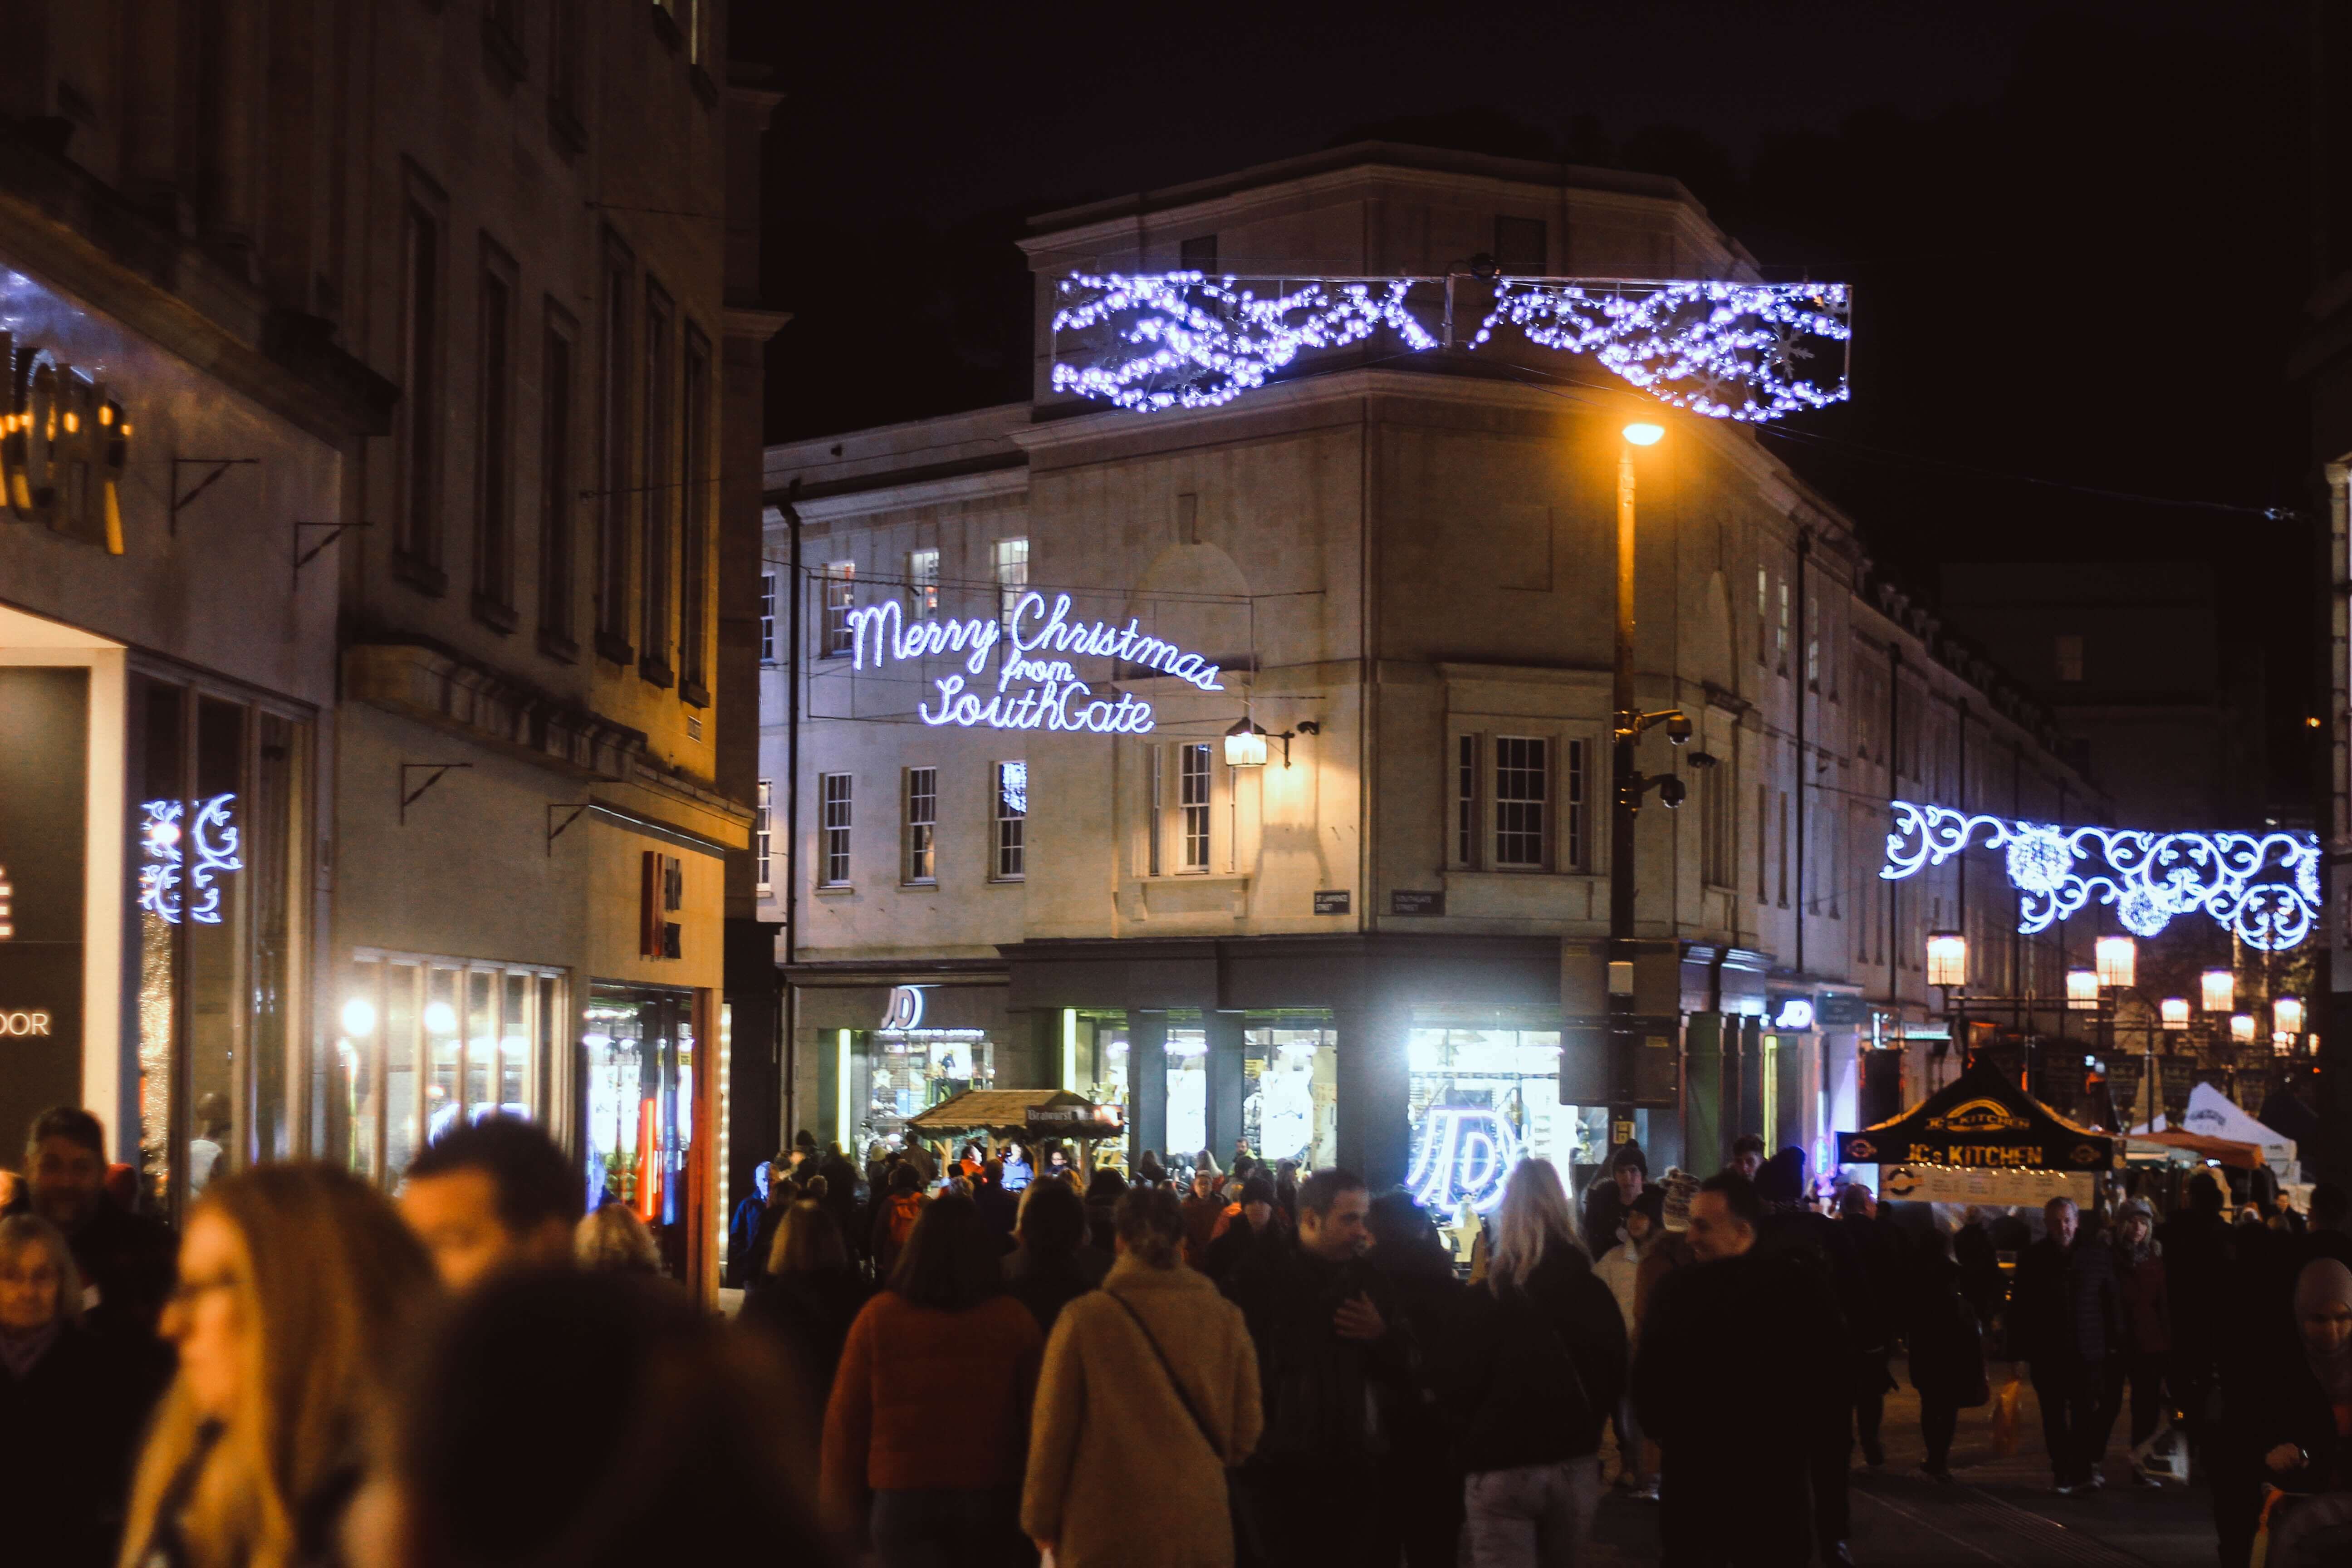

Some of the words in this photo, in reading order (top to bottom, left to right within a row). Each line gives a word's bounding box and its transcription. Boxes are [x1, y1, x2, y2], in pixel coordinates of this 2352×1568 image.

[847, 600, 1000, 675] Merry
[1009, 591, 1225, 691] Christmas
[998, 648, 1075, 694] from
[918, 675, 1155, 734] SouthGate
[881, 985, 923, 1030] JD
